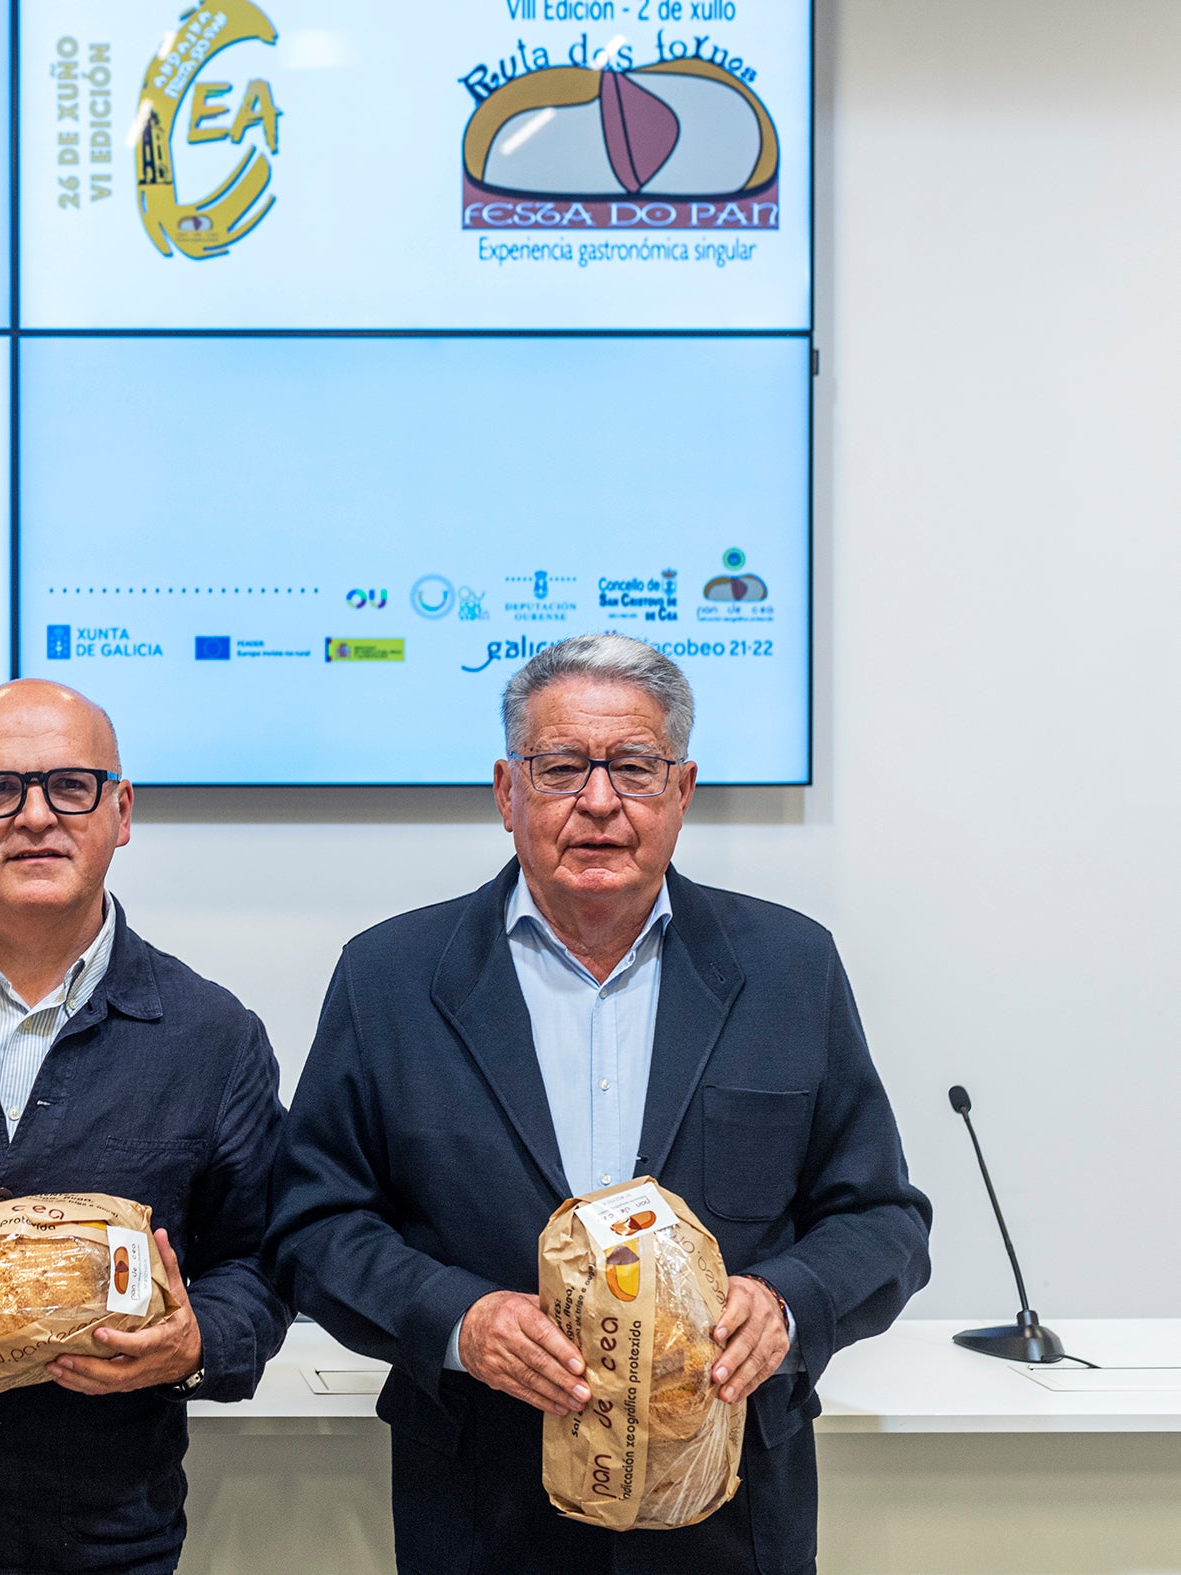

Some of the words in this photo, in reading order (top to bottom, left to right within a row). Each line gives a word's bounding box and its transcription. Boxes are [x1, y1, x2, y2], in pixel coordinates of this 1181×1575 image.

[657, 0, 682, 21] de
[49, 36, 80, 123] XUÑO
[81, 43, 113, 164] EDICIÓN
[57, 131, 81, 166] DE
[57, 175, 81, 210] 26
[90, 174, 113, 203] VI
[478, 236, 573, 267] Experiencia
[577, 237, 690, 268] gastronómica
[694, 237, 758, 268] singular
[598, 577, 645, 592] Concello
[76, 643, 96, 658] DE
[100, 643, 164, 658] GALICIA
[77, 627, 131, 642] XUNTA
[11, 1203, 66, 1222] cea
[599, 1316, 619, 1372] cea
[626, 1320, 642, 1384] protexida
[593, 1399, 614, 1430] de
[623, 1387, 638, 1448] xeográfica
[592, 1453, 618, 1500] pan
[619, 1450, 635, 1502] indicación
